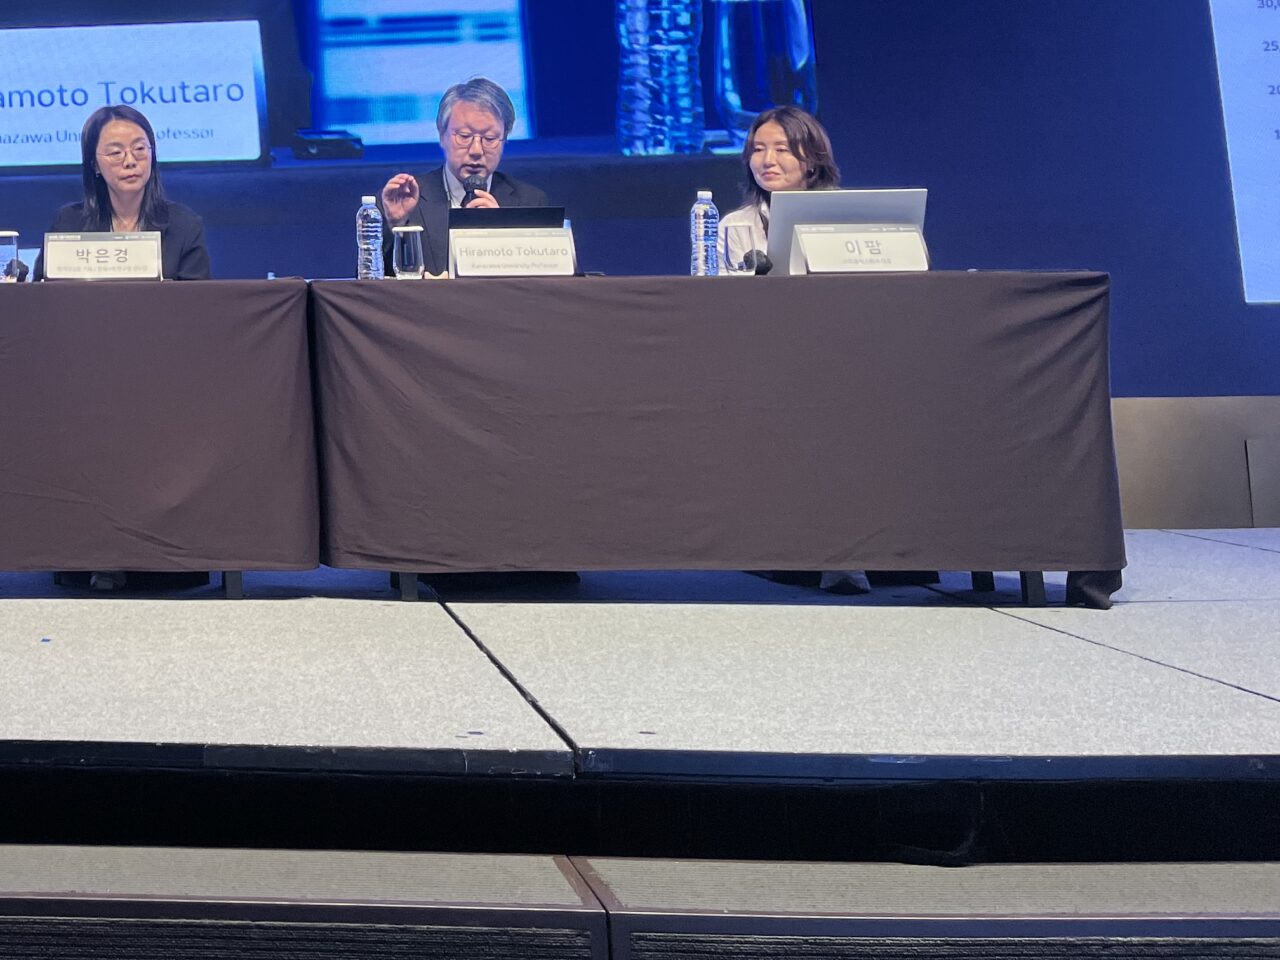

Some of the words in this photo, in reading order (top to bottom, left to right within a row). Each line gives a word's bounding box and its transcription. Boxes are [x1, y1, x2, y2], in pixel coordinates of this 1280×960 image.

[97, 79, 245, 106] Tokutaro
[460, 248, 513, 257] Hiramoto
[515, 246, 568, 257] Tokutaro
